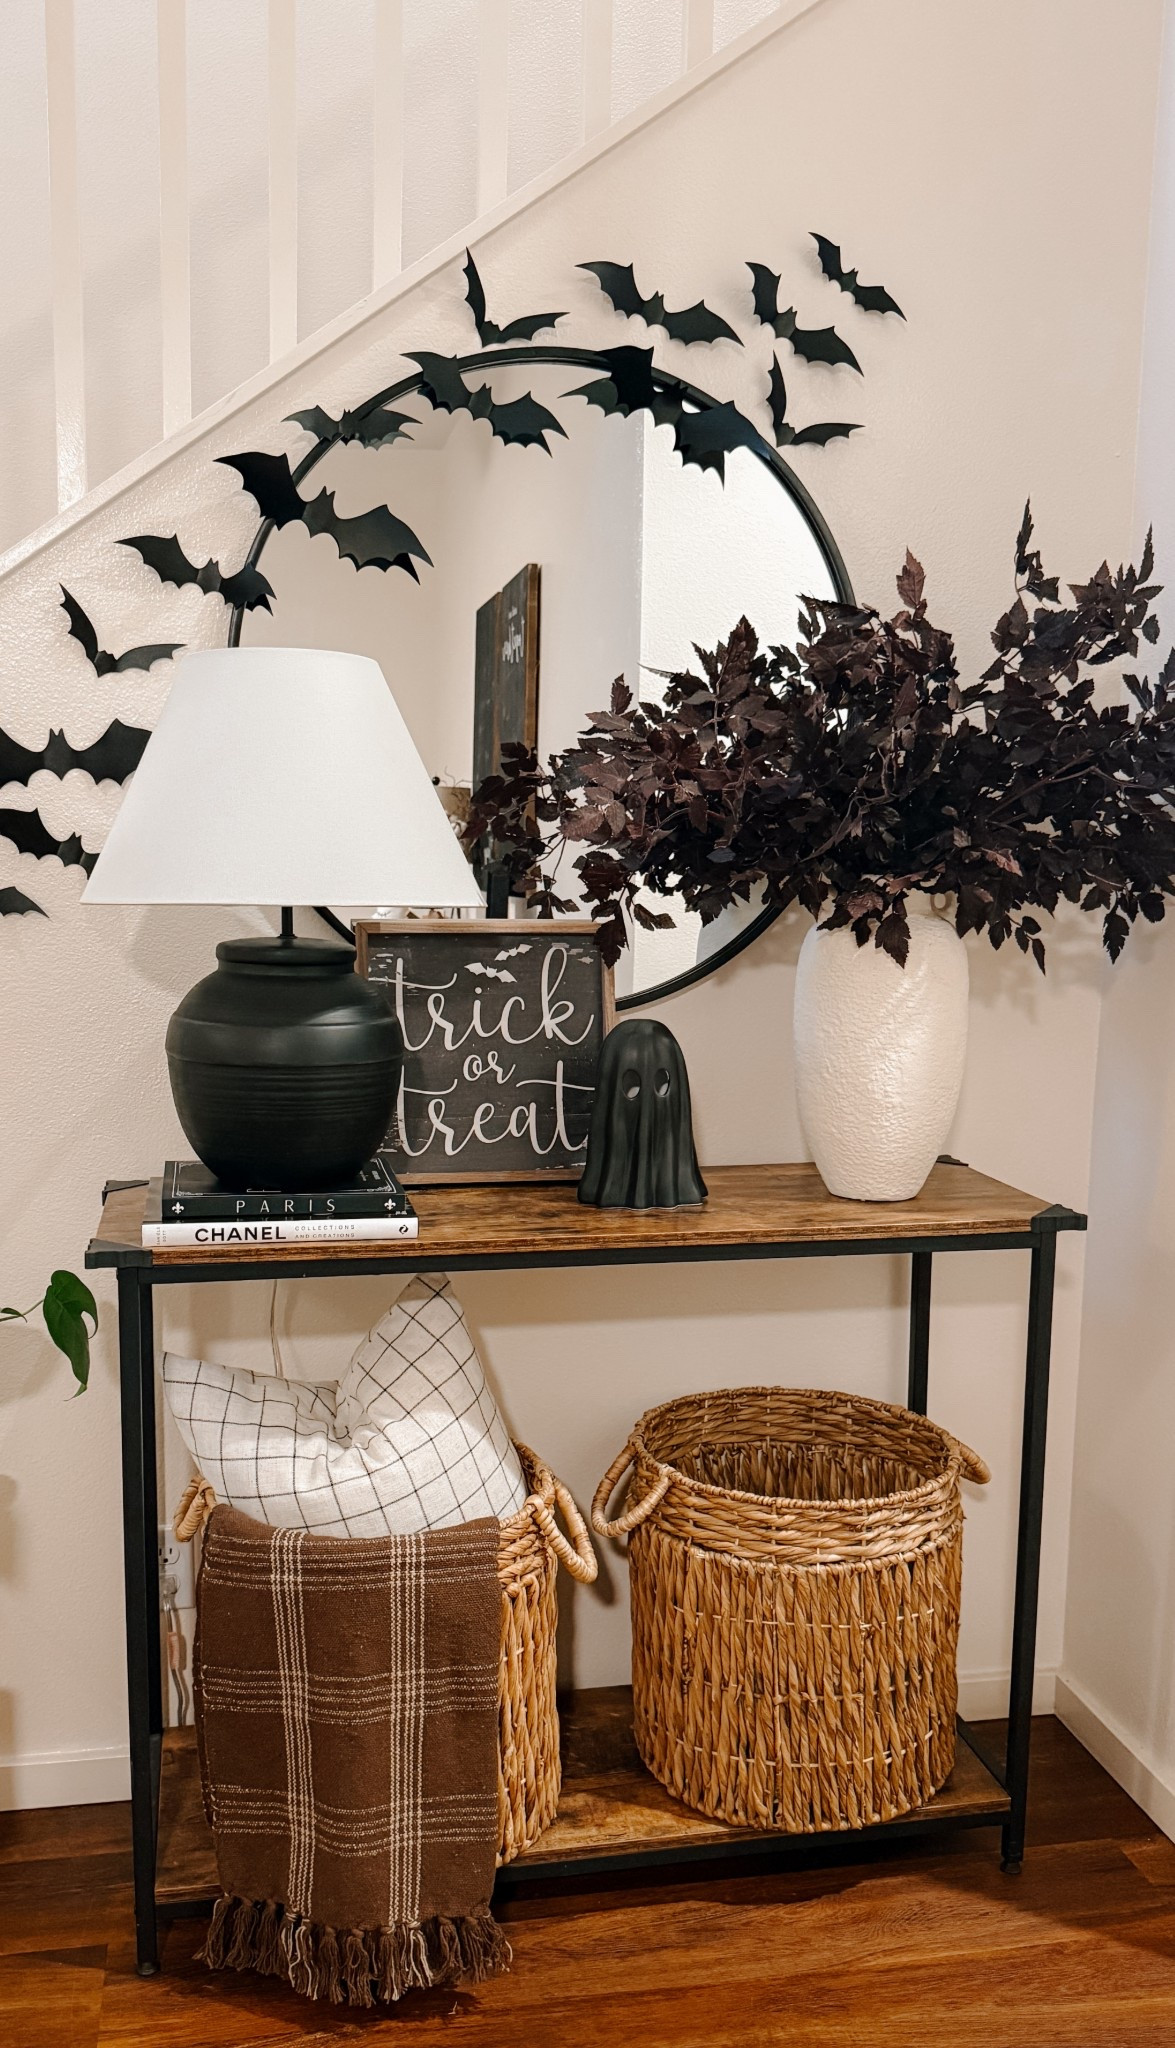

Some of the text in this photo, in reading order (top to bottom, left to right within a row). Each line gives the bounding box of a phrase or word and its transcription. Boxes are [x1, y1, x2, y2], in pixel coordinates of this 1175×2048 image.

[368, 947, 595, 1051] trick
[463, 1051, 516, 1084] or
[397, 1060, 596, 1157] treat
[236, 1199, 336, 1214] PARIS
[195, 1226, 287, 1242] CHANEL
